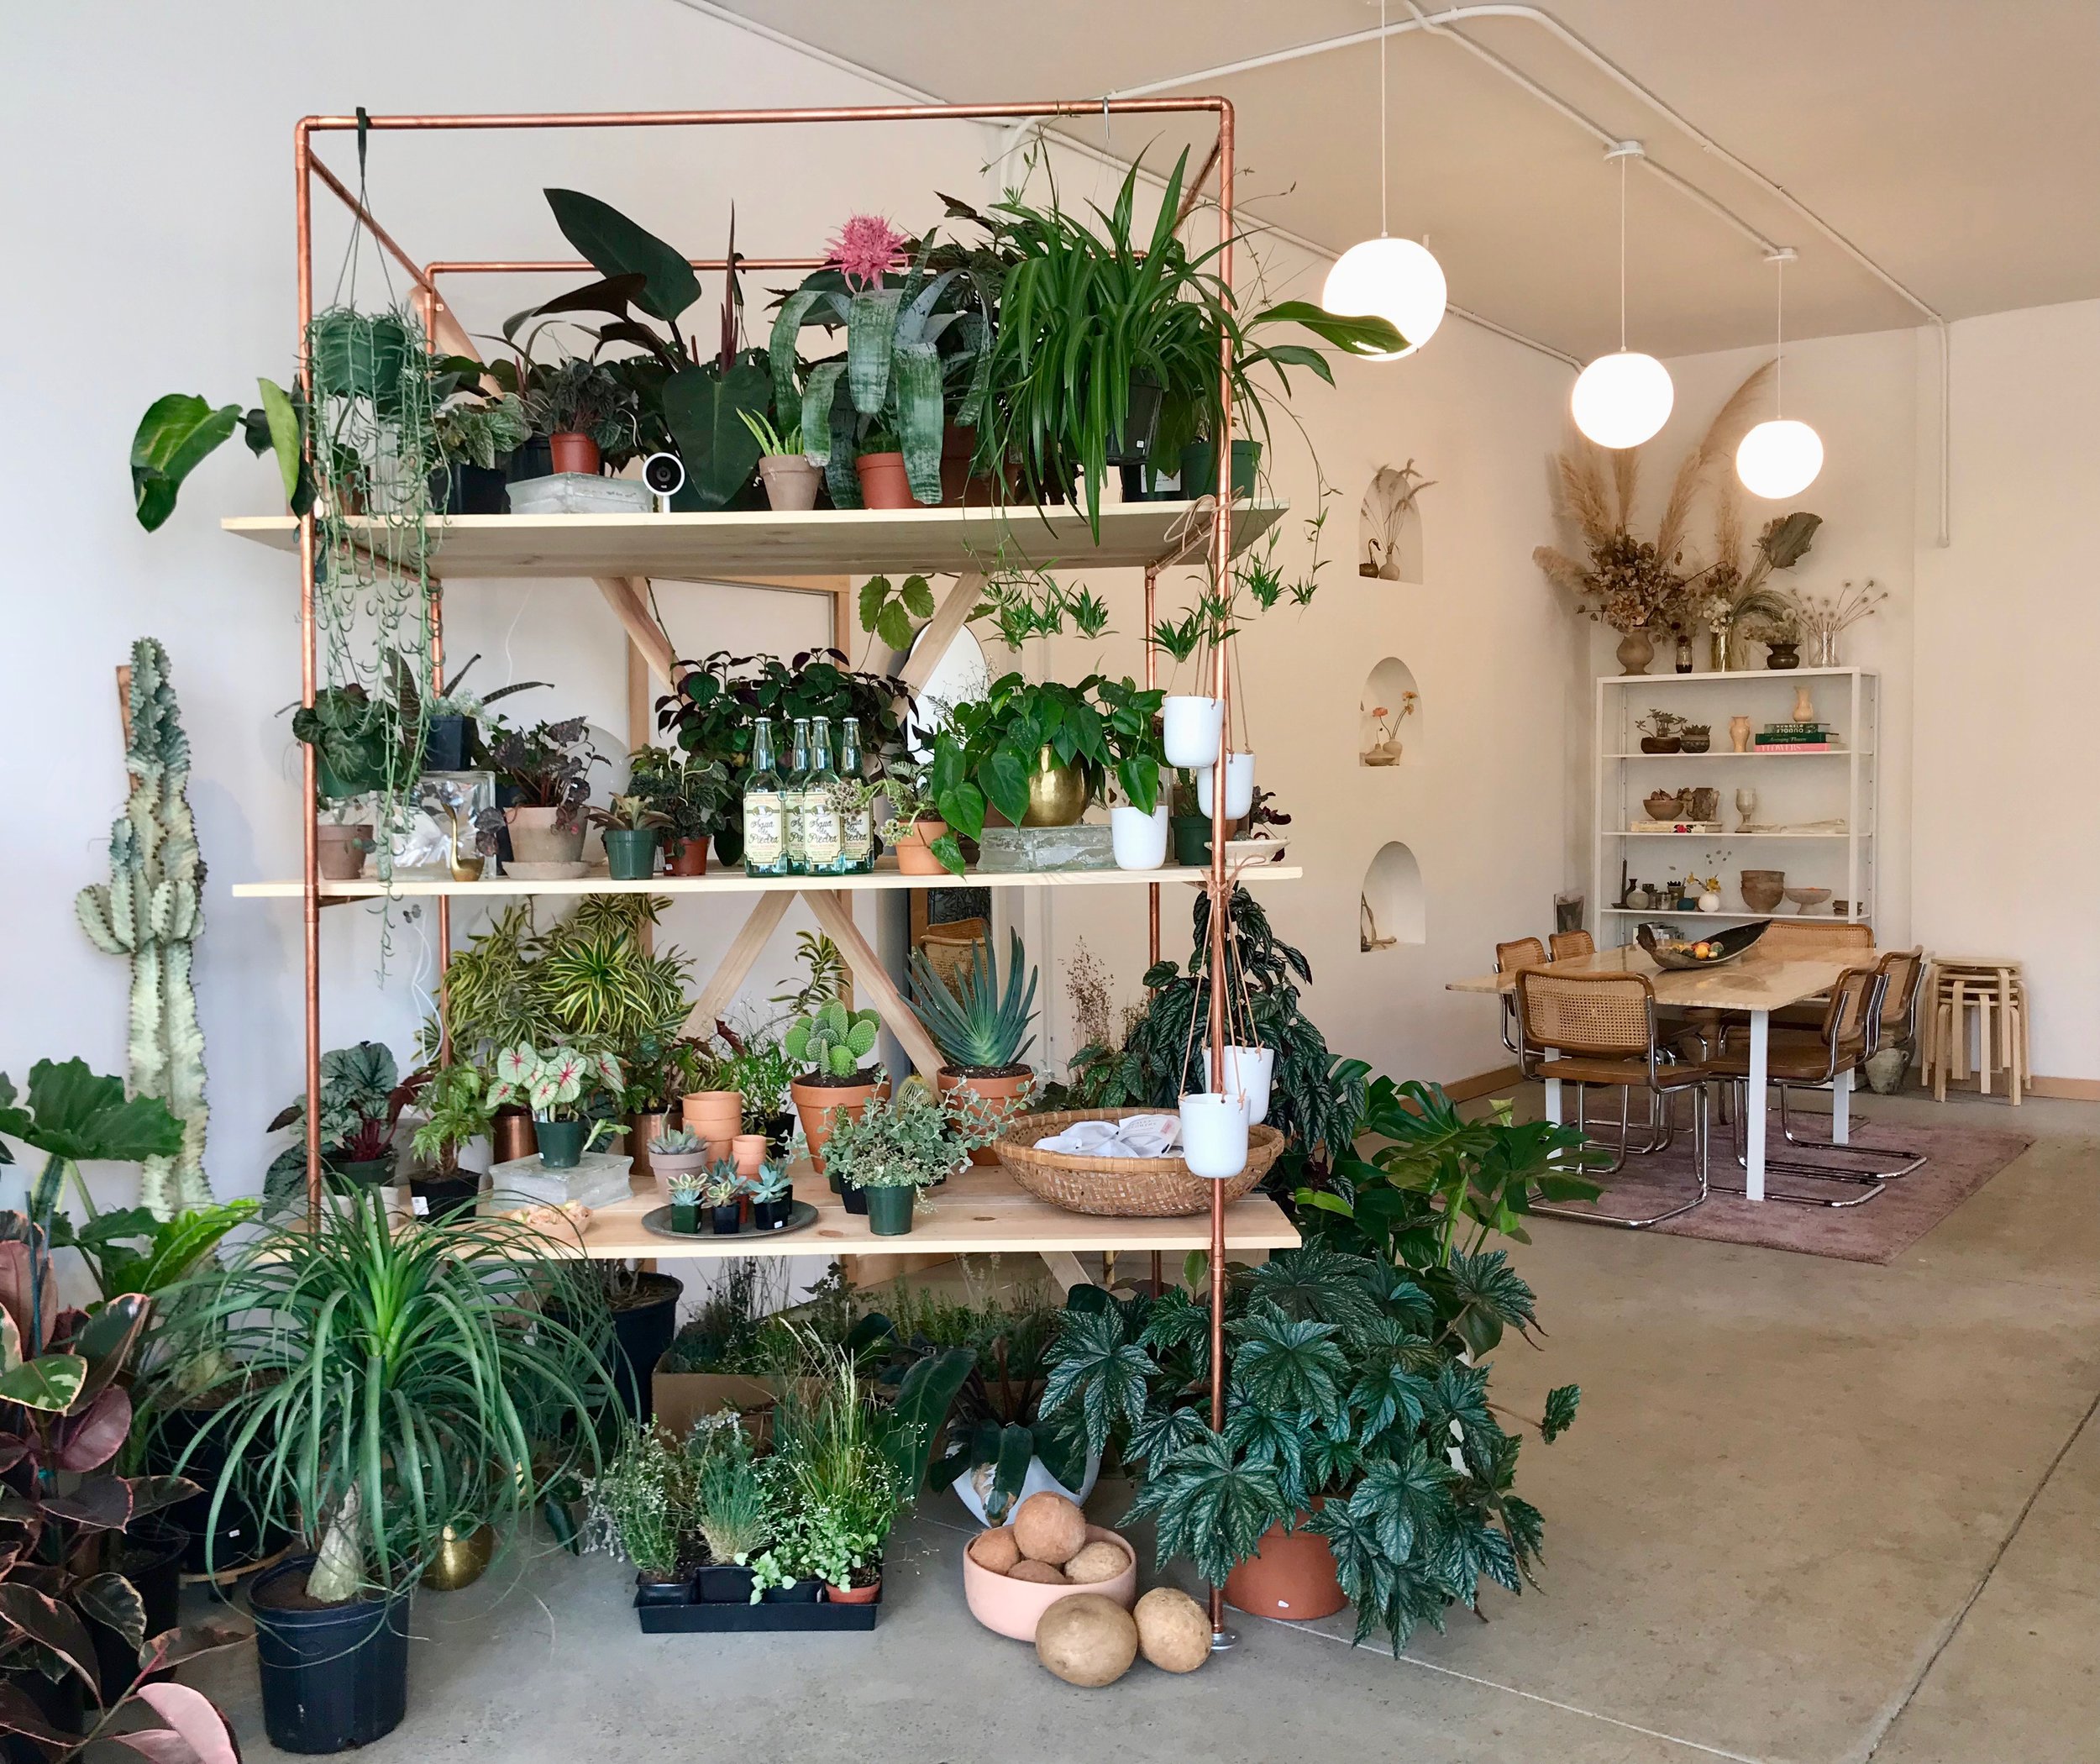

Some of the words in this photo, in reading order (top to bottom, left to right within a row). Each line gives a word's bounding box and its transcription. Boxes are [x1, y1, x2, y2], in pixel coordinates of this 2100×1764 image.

[751, 818, 774, 829] Agua
[810, 818, 832, 828] Agua
[748, 833, 780, 844] Piedra
[808, 832, 838, 843] Piedra
